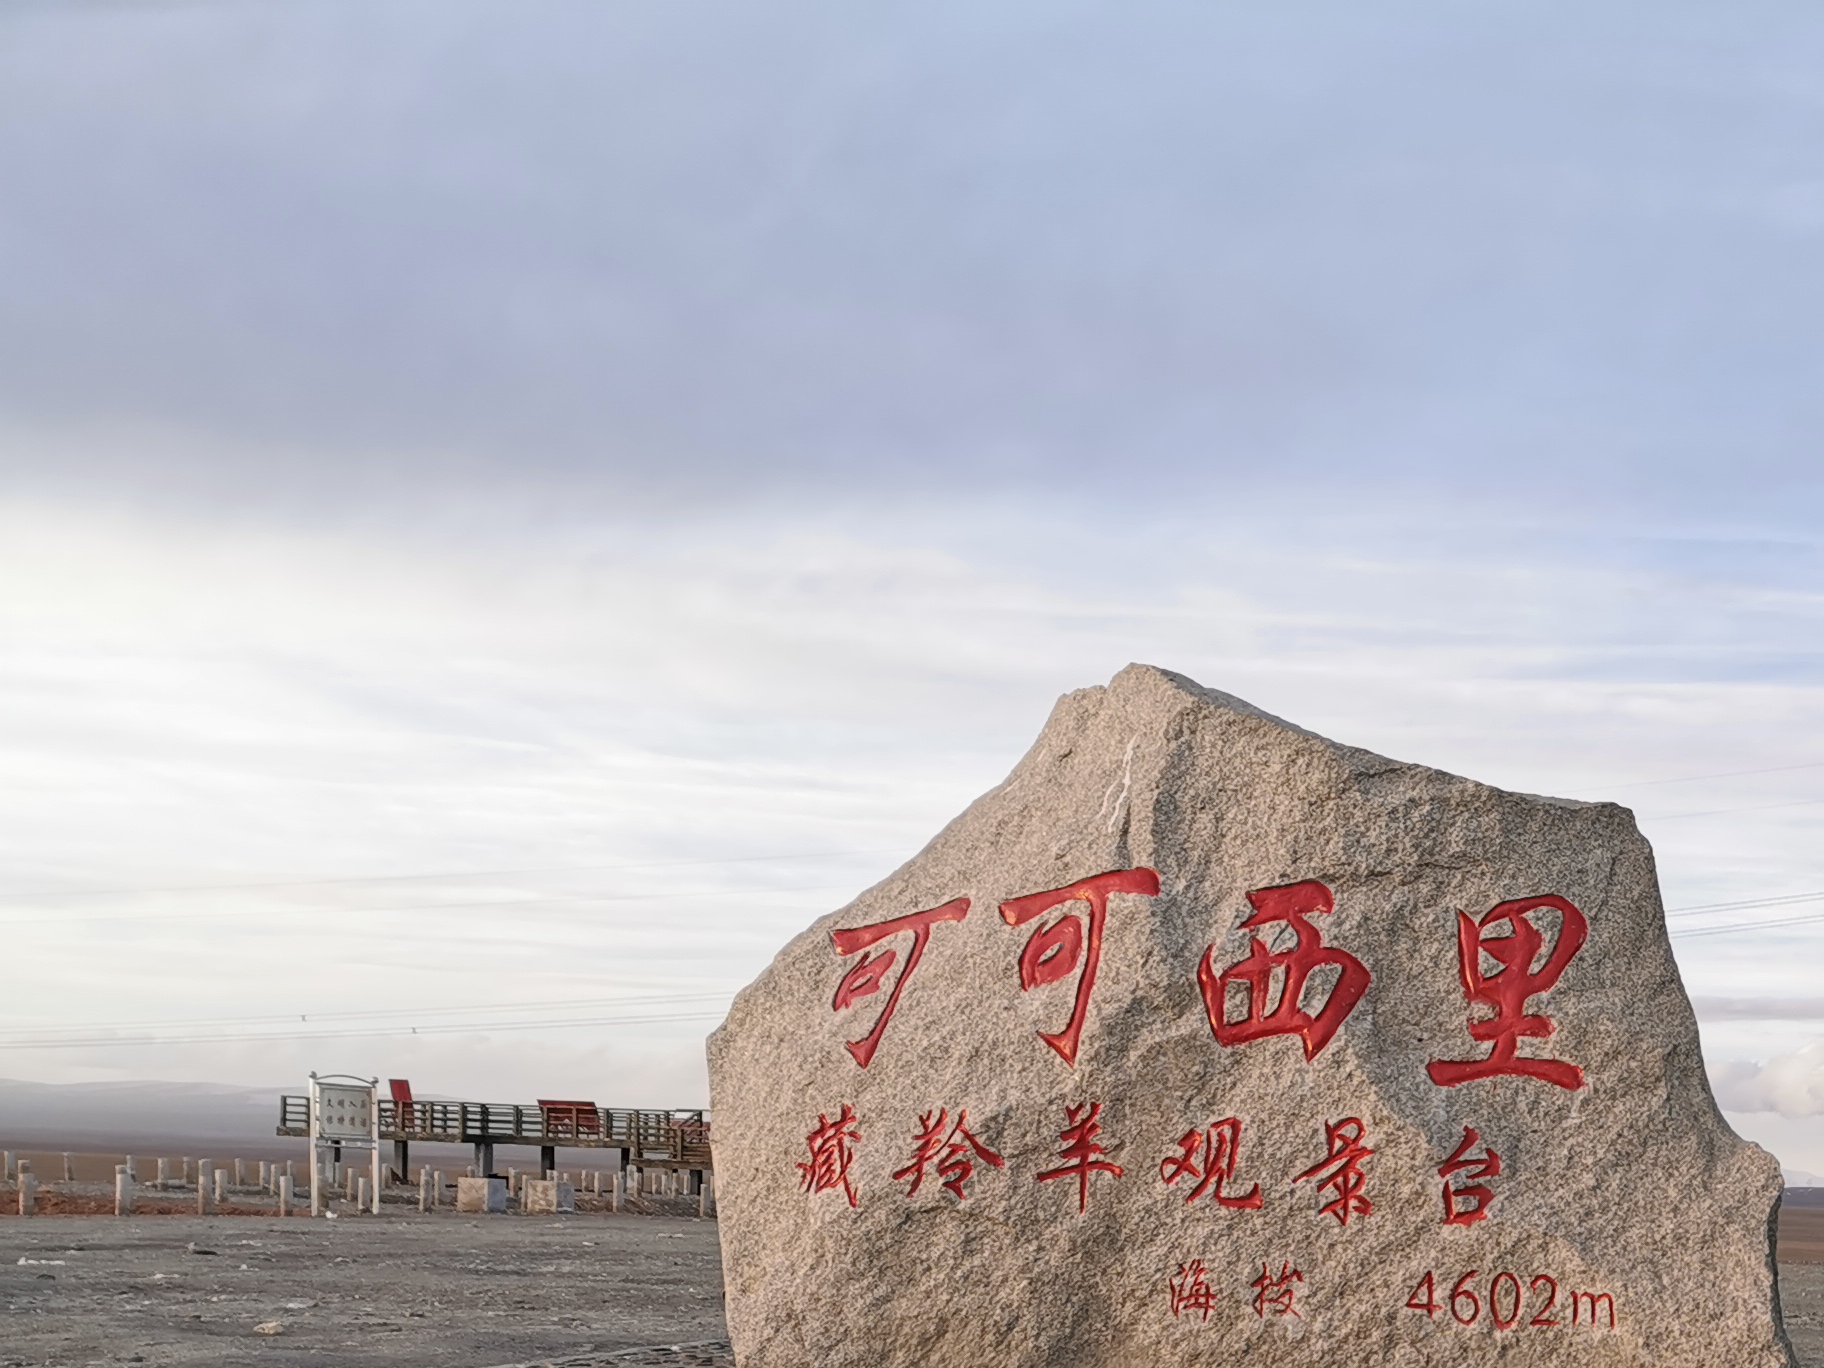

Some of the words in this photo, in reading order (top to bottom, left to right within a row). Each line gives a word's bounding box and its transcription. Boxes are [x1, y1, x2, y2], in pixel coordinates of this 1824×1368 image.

[830, 866, 1589, 1092] 可可西里
[797, 1102, 1504, 1228] 藏羚羊观景台
[1169, 1258, 1304, 1323] 海拔
[1405, 1269, 1616, 1331] 4602m
